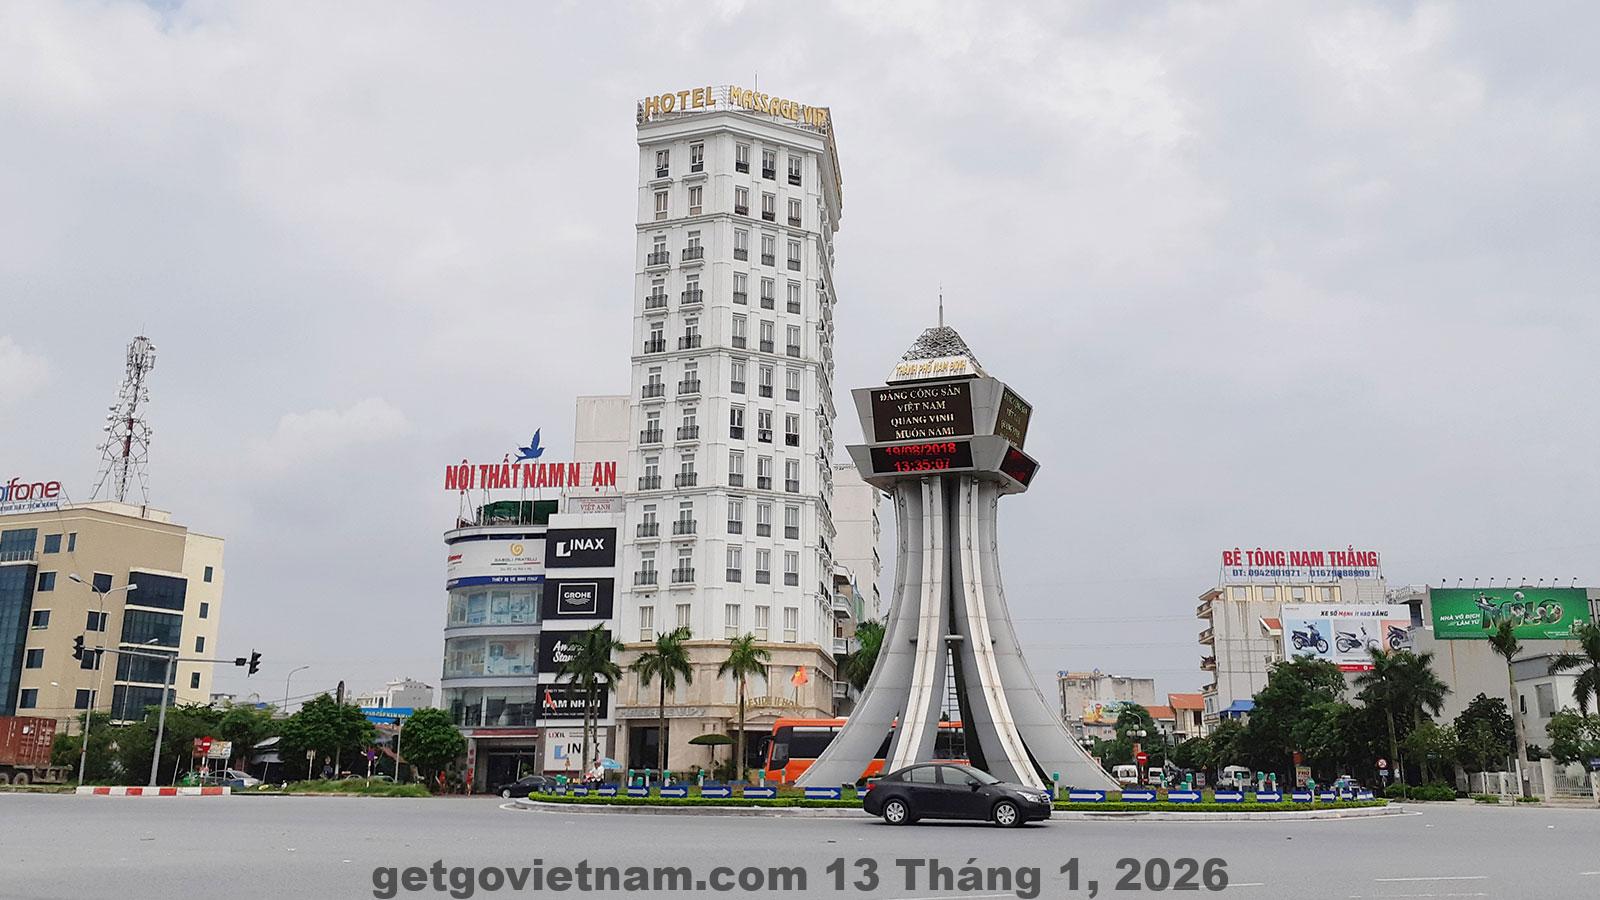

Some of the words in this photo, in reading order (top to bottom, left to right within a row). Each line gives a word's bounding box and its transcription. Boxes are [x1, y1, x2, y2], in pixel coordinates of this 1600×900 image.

[644, 86, 717, 120] HOTEL
[729, 85, 799, 122] MASSAGE
[897, 402, 921, 414] VIỆT
[922, 400, 946, 411] NAM
[890, 416, 927, 428] QUANG
[929, 413, 954, 426] VINH
[445, 459, 476, 495] NỘI
[479, 455, 520, 489] THẤT
[523, 463, 565, 488] NAM
[570, 539, 604, 551] INAX
[1223, 548, 1242, 567] BÊ
[1246, 548, 1285, 567] TÔNG
[1290, 551, 1324, 567] NAM
[1328, 545, 1377, 567] THẮNG
[564, 591, 592, 599] GROHE
[568, 743, 600, 754] INX
